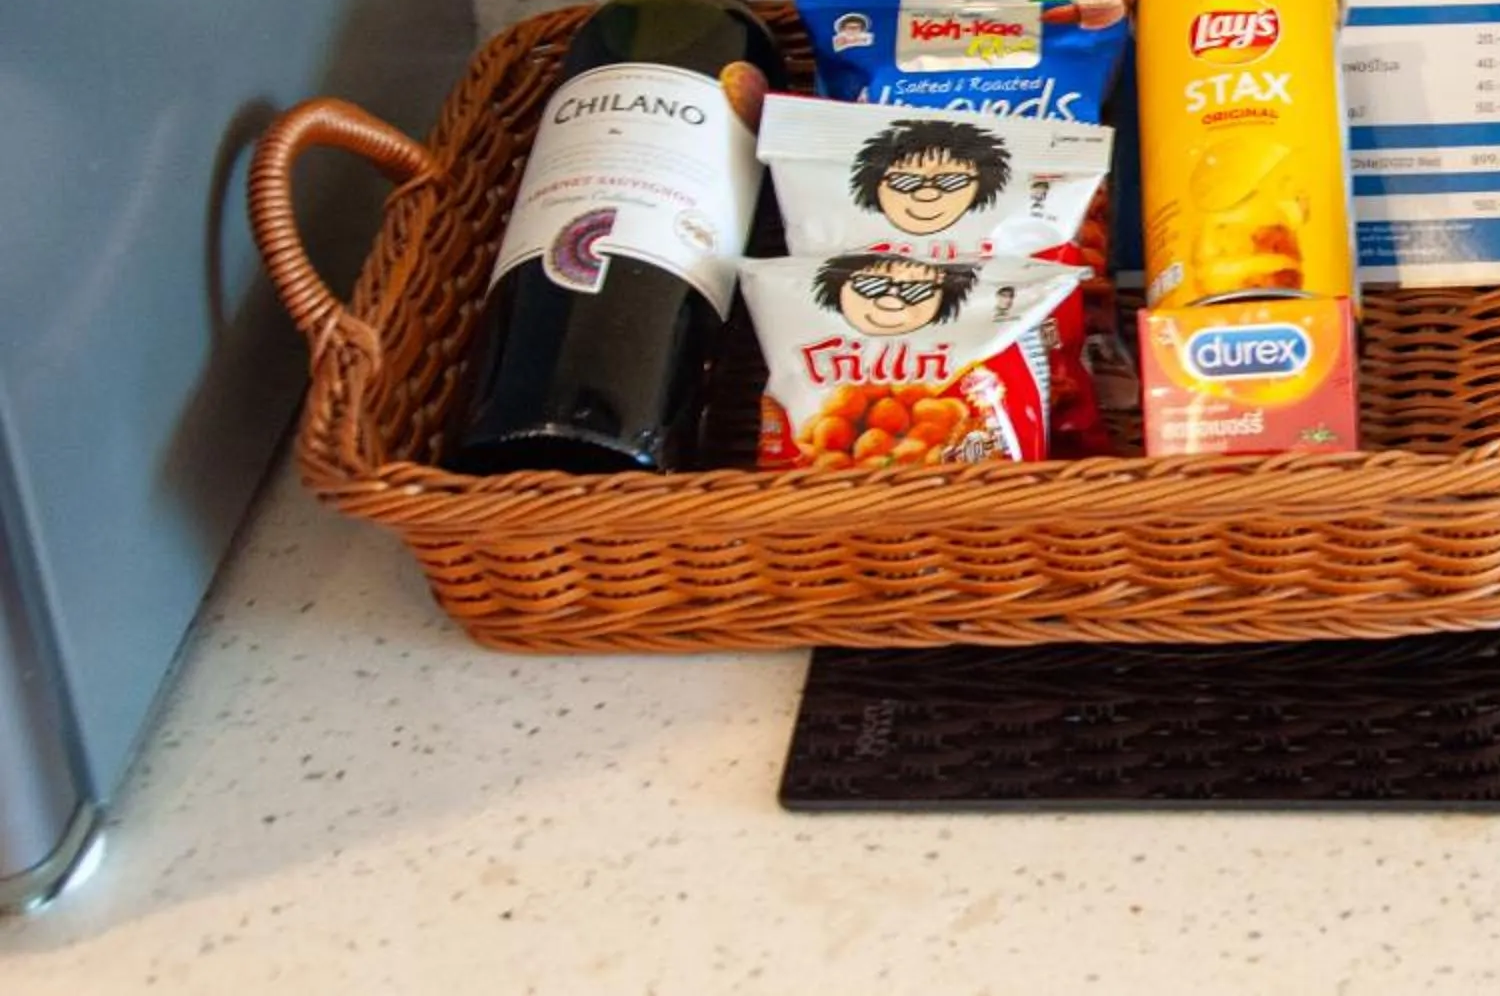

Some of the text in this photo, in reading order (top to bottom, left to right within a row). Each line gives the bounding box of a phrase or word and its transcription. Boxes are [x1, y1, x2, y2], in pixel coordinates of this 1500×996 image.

[911, 18, 1024, 41] Koh-Kae
[1194, 8, 1277, 50] Lay's
[895, 78, 950, 95] Salted
[968, 76, 1041, 92] Roasted
[1184, 72, 1294, 113] STAX
[553, 93, 706, 126] CHILANO
[1201, 108, 1279, 125] ORIGINAL
[1196, 336, 1299, 368] durex
